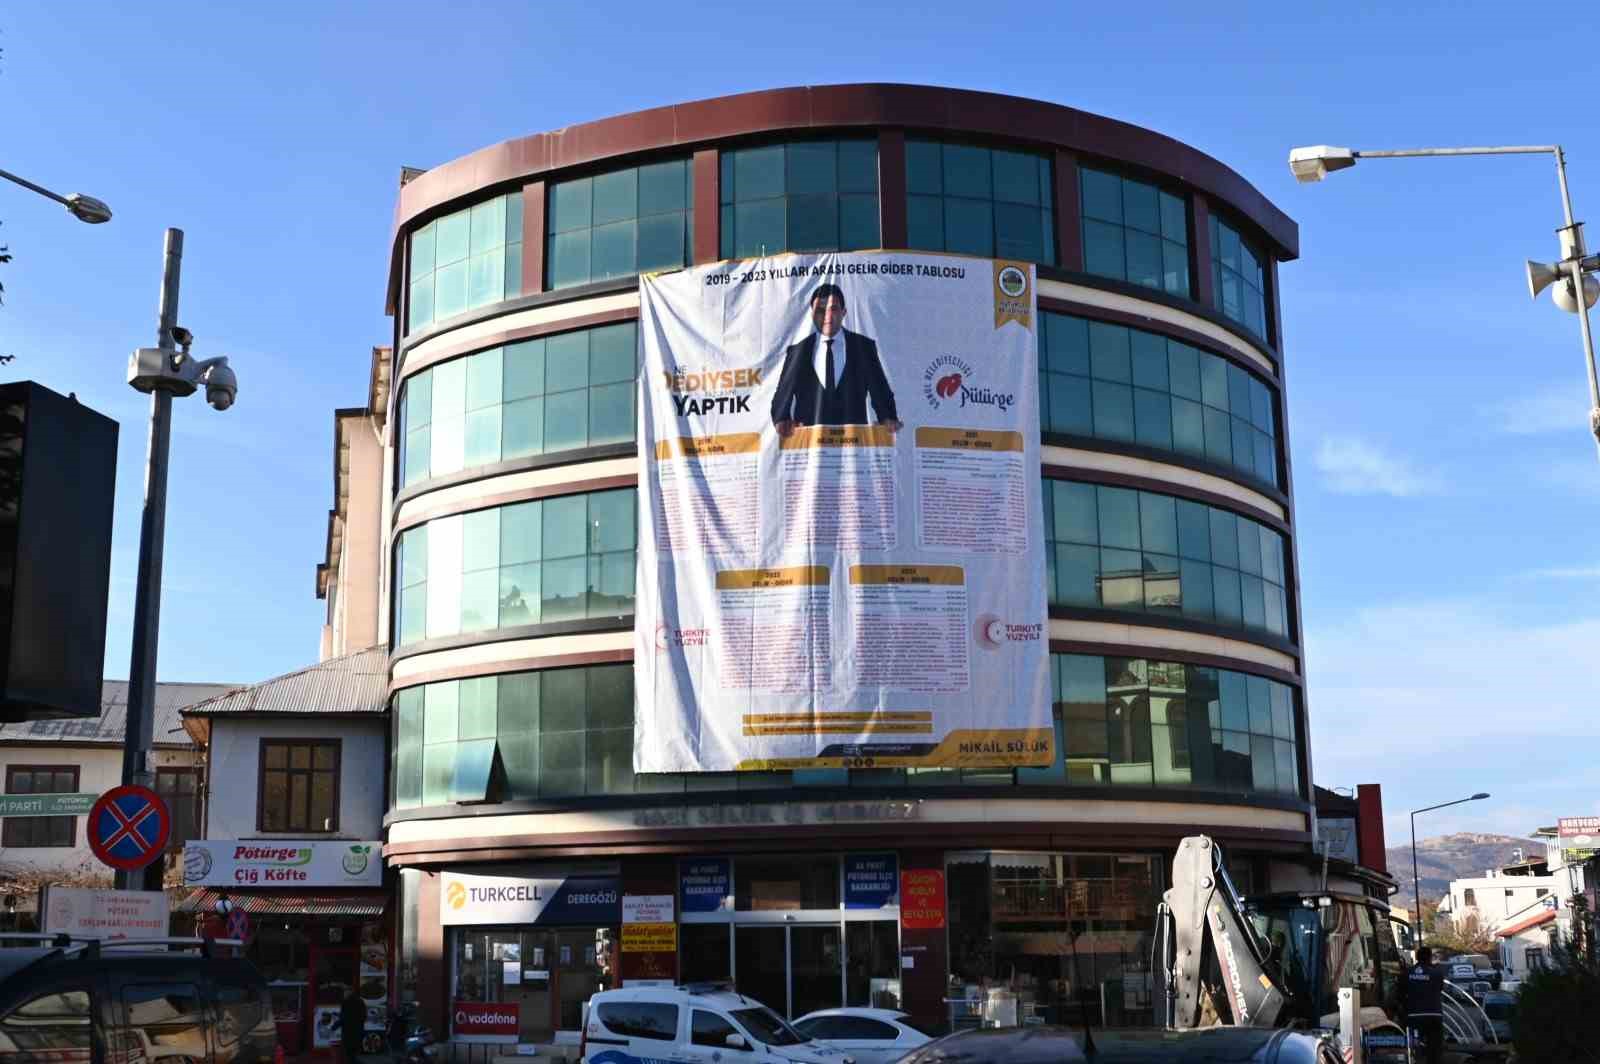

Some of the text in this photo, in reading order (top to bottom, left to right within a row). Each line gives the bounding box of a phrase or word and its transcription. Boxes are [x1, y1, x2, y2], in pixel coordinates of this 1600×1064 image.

[706, 274, 731, 285] 2019
[741, 270, 766, 284] 2023
[770, 267, 809, 280] YILLARI
[812, 265, 845, 278] ARASI
[848, 263, 878, 275] GELİR
[881, 262, 913, 276] GİDER
[917, 266, 966, 279] TABLOSU
[673, 394, 751, 416] YAPTIK
[959, 738, 1004, 752] MİKAİL
[9, 799, 42, 812] PARTİ
[235, 868, 307, 884] Çiğ Köfte
[470, 886, 542, 902] TURKCELL
[567, 891, 617, 905] DEREGÖZÜ
[468, 1011, 517, 1025] vodafone
